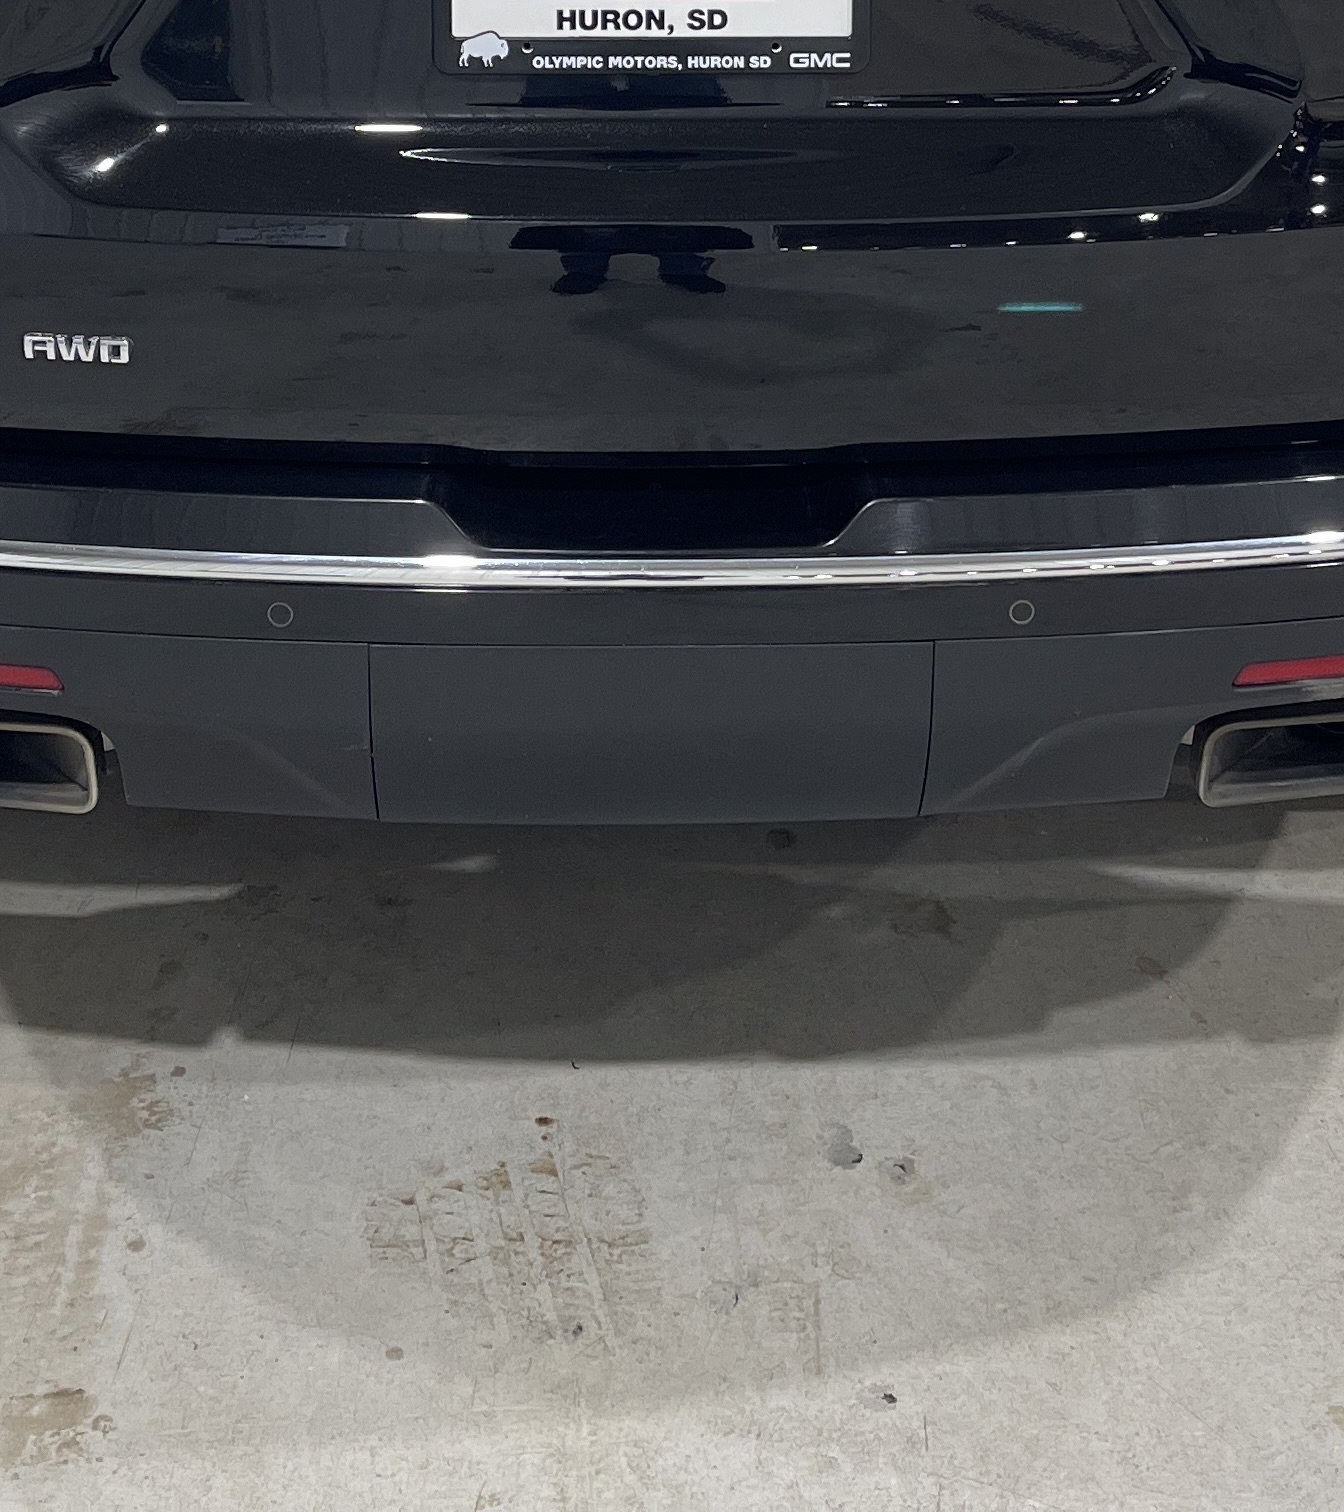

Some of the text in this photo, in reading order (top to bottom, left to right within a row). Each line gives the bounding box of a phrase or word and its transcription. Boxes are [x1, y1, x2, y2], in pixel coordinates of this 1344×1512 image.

[556, 9, 728, 35] HURON, SD
[532, 55, 771, 70] OLYMPIC MOTORS, HURON SD
[789, 52, 851, 68] GMC
[22, 331, 134, 364] AWD
